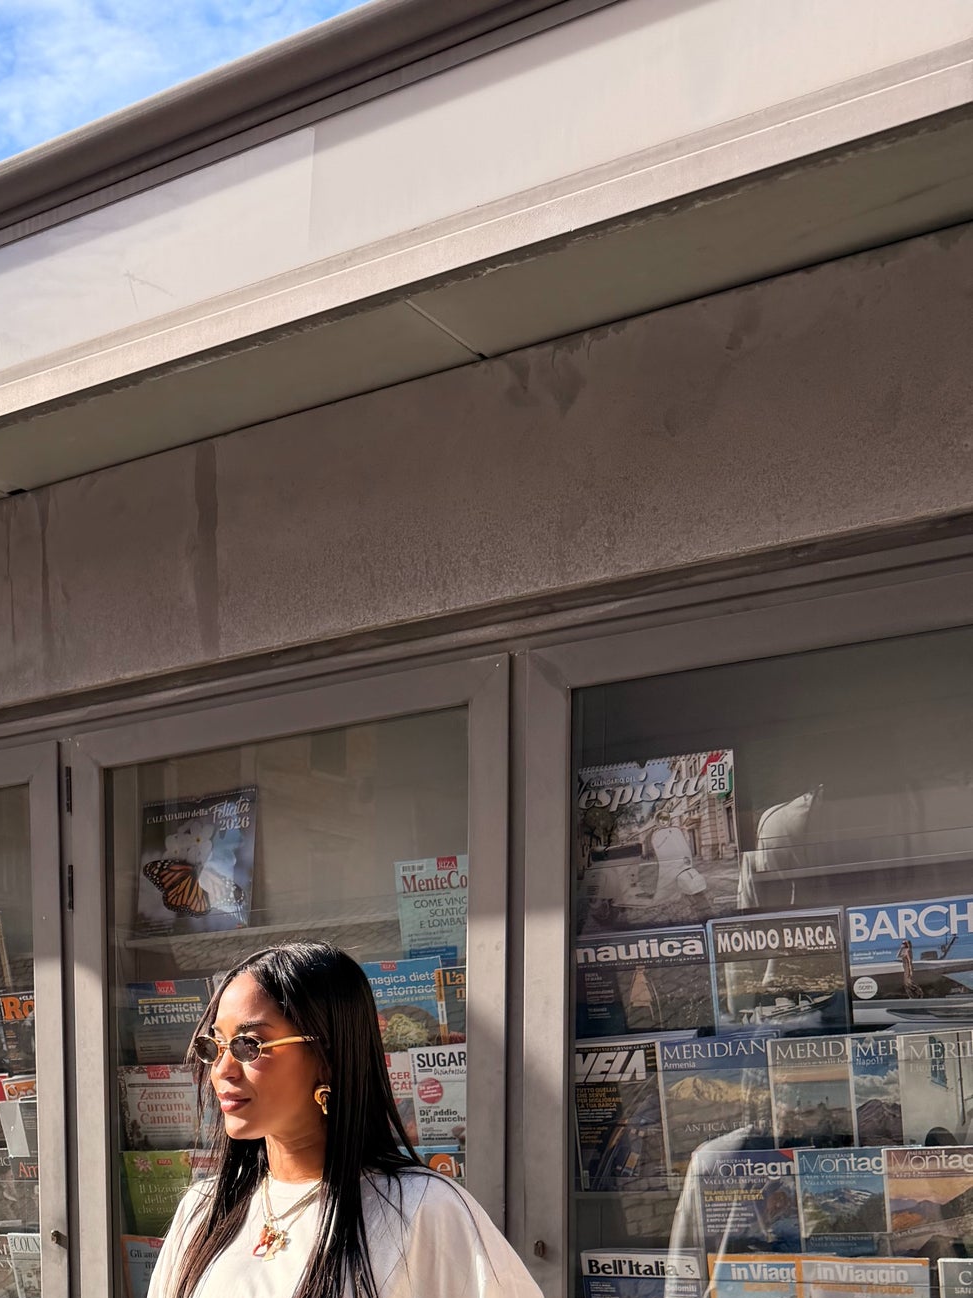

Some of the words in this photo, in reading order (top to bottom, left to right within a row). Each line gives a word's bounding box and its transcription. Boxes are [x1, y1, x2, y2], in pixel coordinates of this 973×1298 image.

[710, 763, 725, 777] 20
[711, 777, 725, 791] 26
[147, 810, 191, 825] CALENDARIO
[191, 807, 209, 818] della
[209, 795, 251, 824] Felicità
[219, 816, 250, 831] 2026
[401, 870, 468, 894] MenteCo
[413, 898, 444, 909] COME
[419, 920, 426, 929] E
[849, 901, 973, 943] BARCH
[717, 928, 780, 954] MONDO
[782, 925, 837, 948] BARCA
[575, 938, 704, 964] nautica
[367, 972, 407, 986] magica
[138, 1006, 150, 1015] LE
[663, 1039, 766, 1061] MERIDIAN
[416, 1051, 467, 1069] SUGAR
[576, 1049, 647, 1083] VELA
[663, 1061, 696, 1069] Armenia
[855, 1056, 884, 1066] Napoli
[139, 1088, 185, 1101] Zenzero
[137, 1100, 192, 1113] Curcuma
[433, 1108, 458, 1117] addio
[139, 1112, 192, 1125] Cannella
[587, 1258, 680, 1277] Bell'Italia
